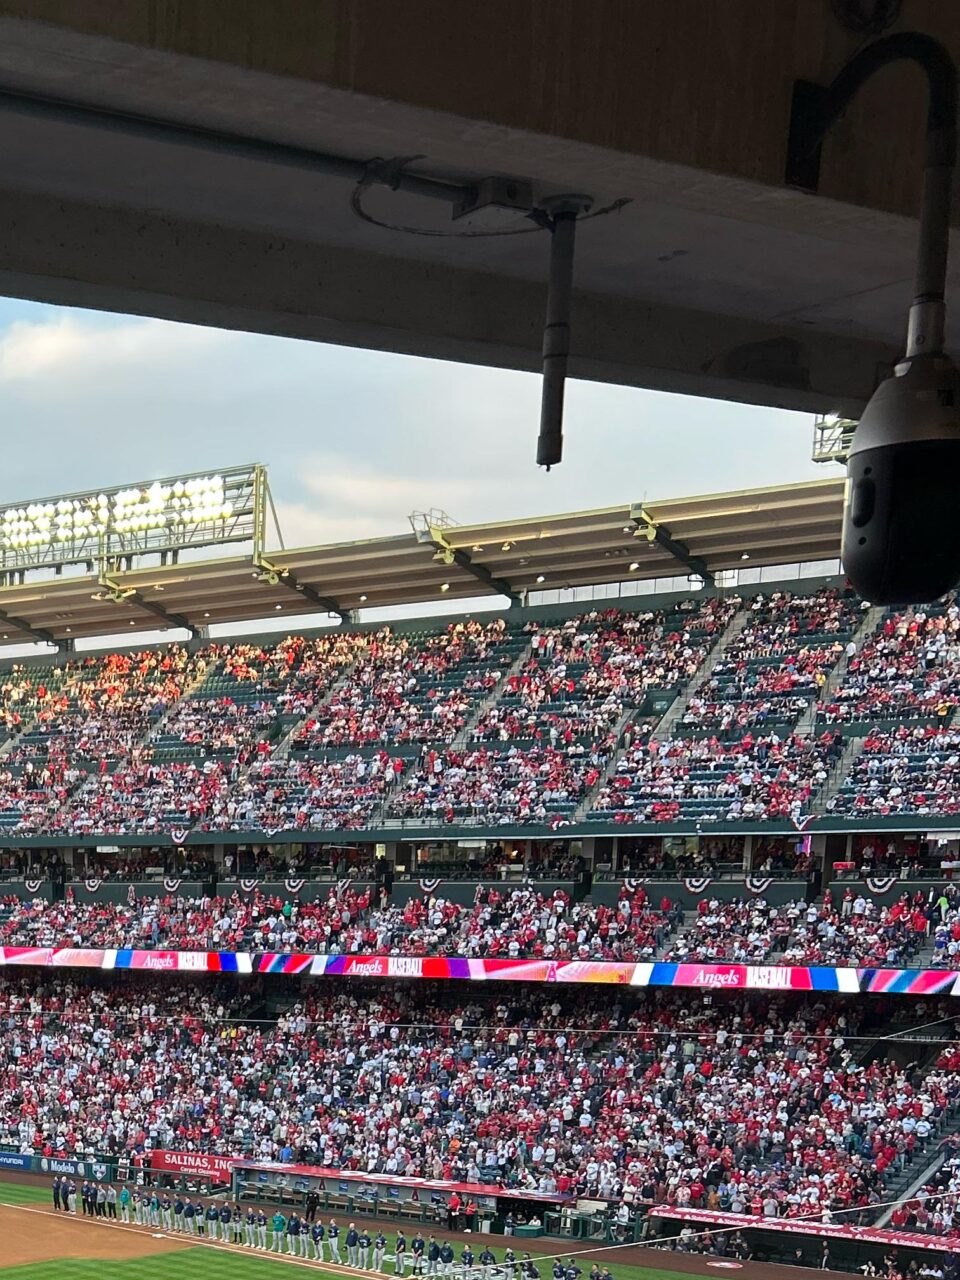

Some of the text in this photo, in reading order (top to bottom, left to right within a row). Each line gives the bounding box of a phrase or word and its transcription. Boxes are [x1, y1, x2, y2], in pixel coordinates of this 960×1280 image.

[143, 954, 175, 968] Angels
[346, 957, 423, 975] Angels BASEBALL
[693, 966, 792, 988] Angels BASEBALL
[50, 1160, 75, 1174] Modelo
[164, 1153, 211, 1169] SALINAS,
[198, 1167, 220, 1176] Cleaning
